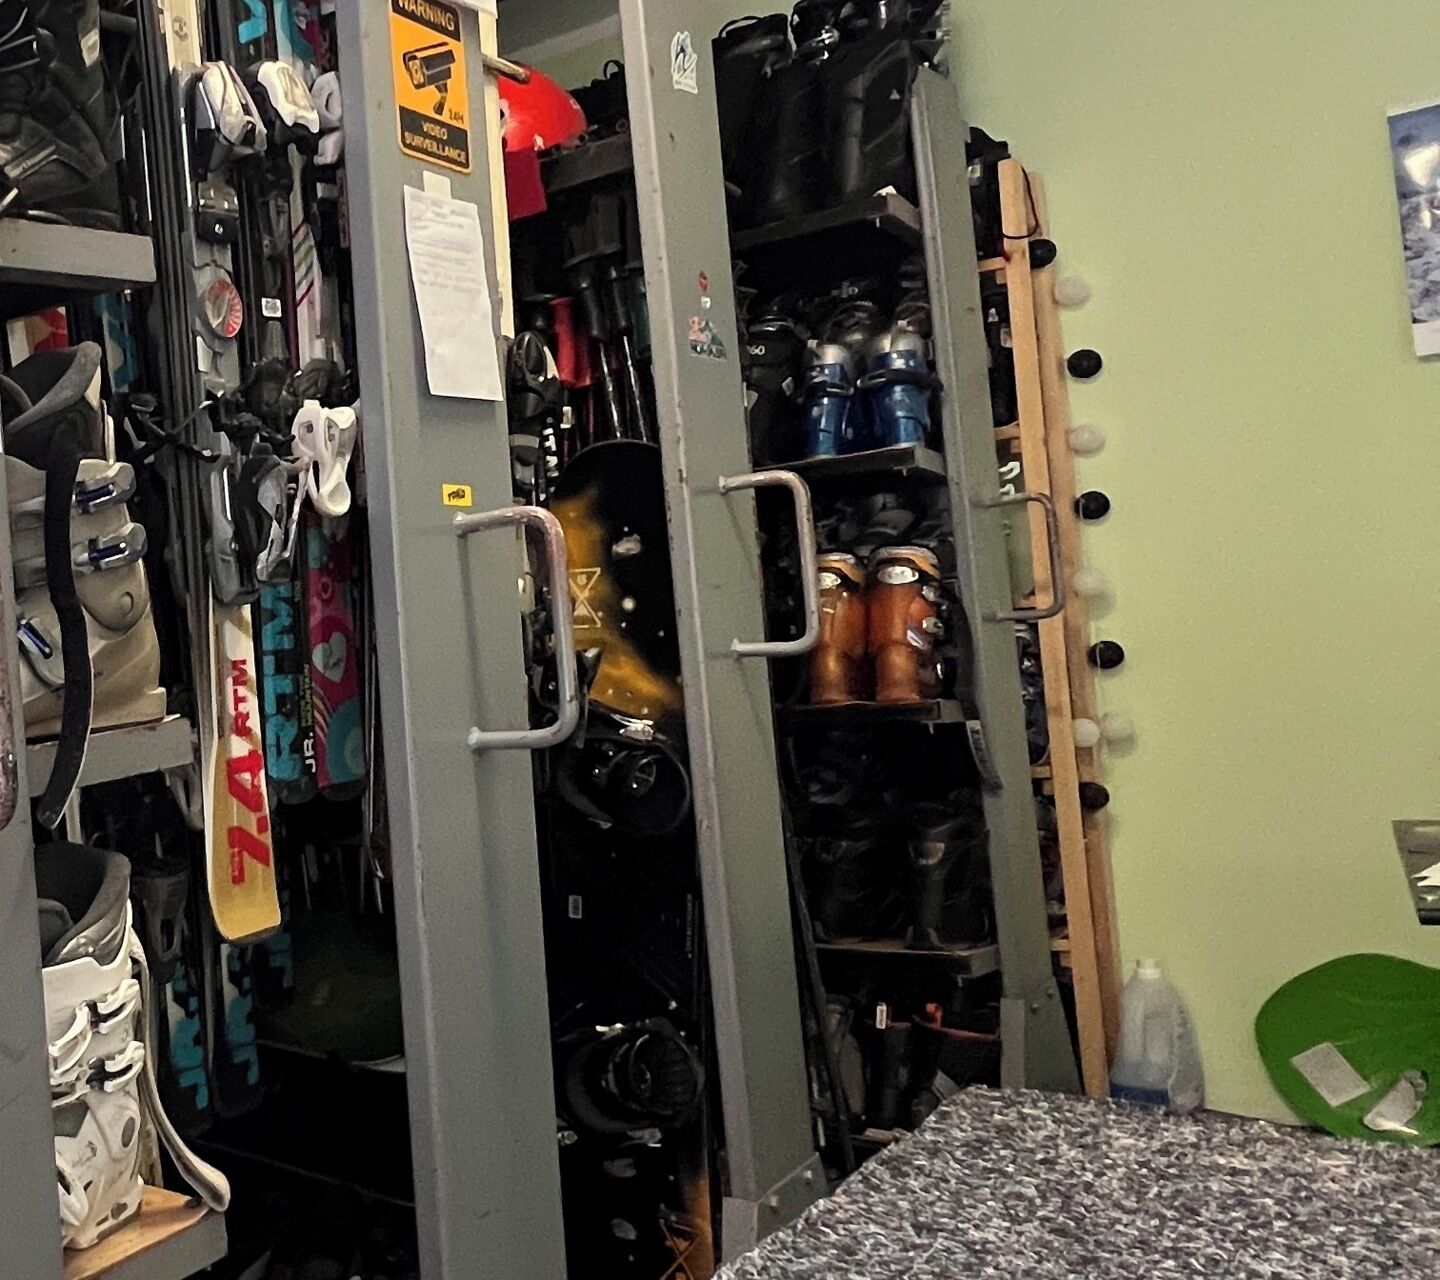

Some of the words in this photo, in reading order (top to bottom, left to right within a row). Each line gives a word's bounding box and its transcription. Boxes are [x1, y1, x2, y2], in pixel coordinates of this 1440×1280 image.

[404, 130, 467, 164] SURVEILLANCE
[422, 120, 448, 141] VIDEO
[230, 658, 252, 738] RTM
[259, 582, 302, 781] RTM
[303, 730, 317, 774] JR.
[224, 747, 271, 886] 7.4
